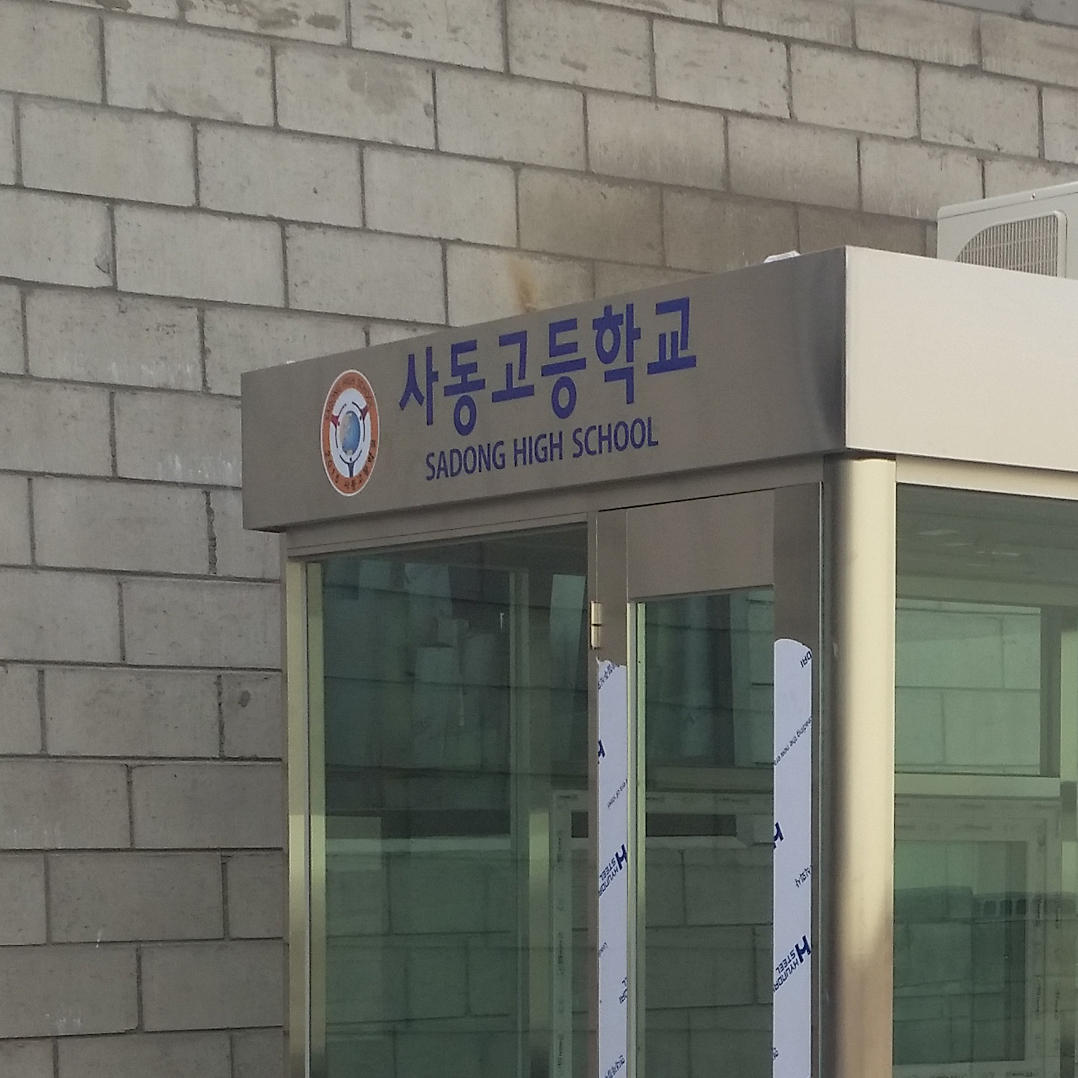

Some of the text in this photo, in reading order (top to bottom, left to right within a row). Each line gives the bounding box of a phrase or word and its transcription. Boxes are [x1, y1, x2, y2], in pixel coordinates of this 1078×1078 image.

[400, 298, 696, 437] 사동고등학교
[426, 416, 659, 481] SADONG HIGH SCHOOL
[599, 856, 617, 880] STEEL
[775, 949, 796, 974] STEEL
